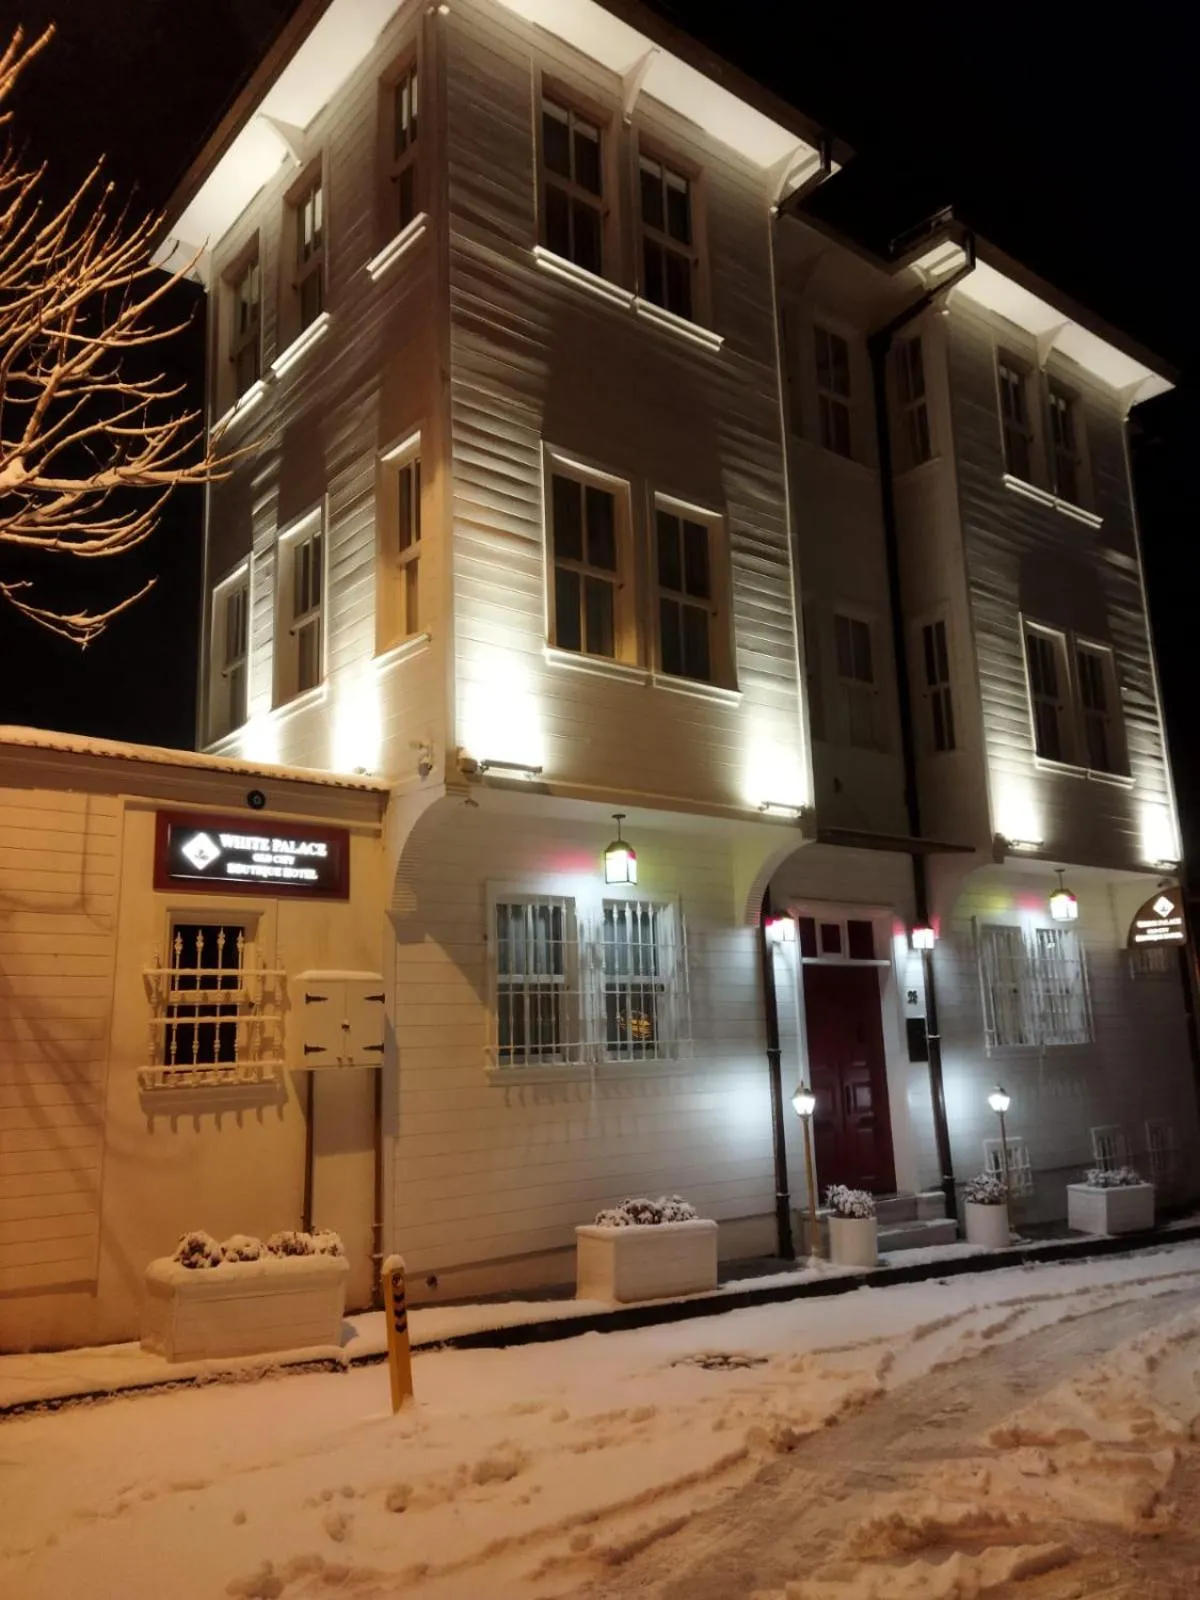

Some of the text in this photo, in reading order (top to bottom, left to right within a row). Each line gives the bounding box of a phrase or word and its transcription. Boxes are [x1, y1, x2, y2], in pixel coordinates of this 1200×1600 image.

[219, 834, 327, 856] WHITE PALACE
[227, 863, 318, 879] BOUTIQUE HOTEL
